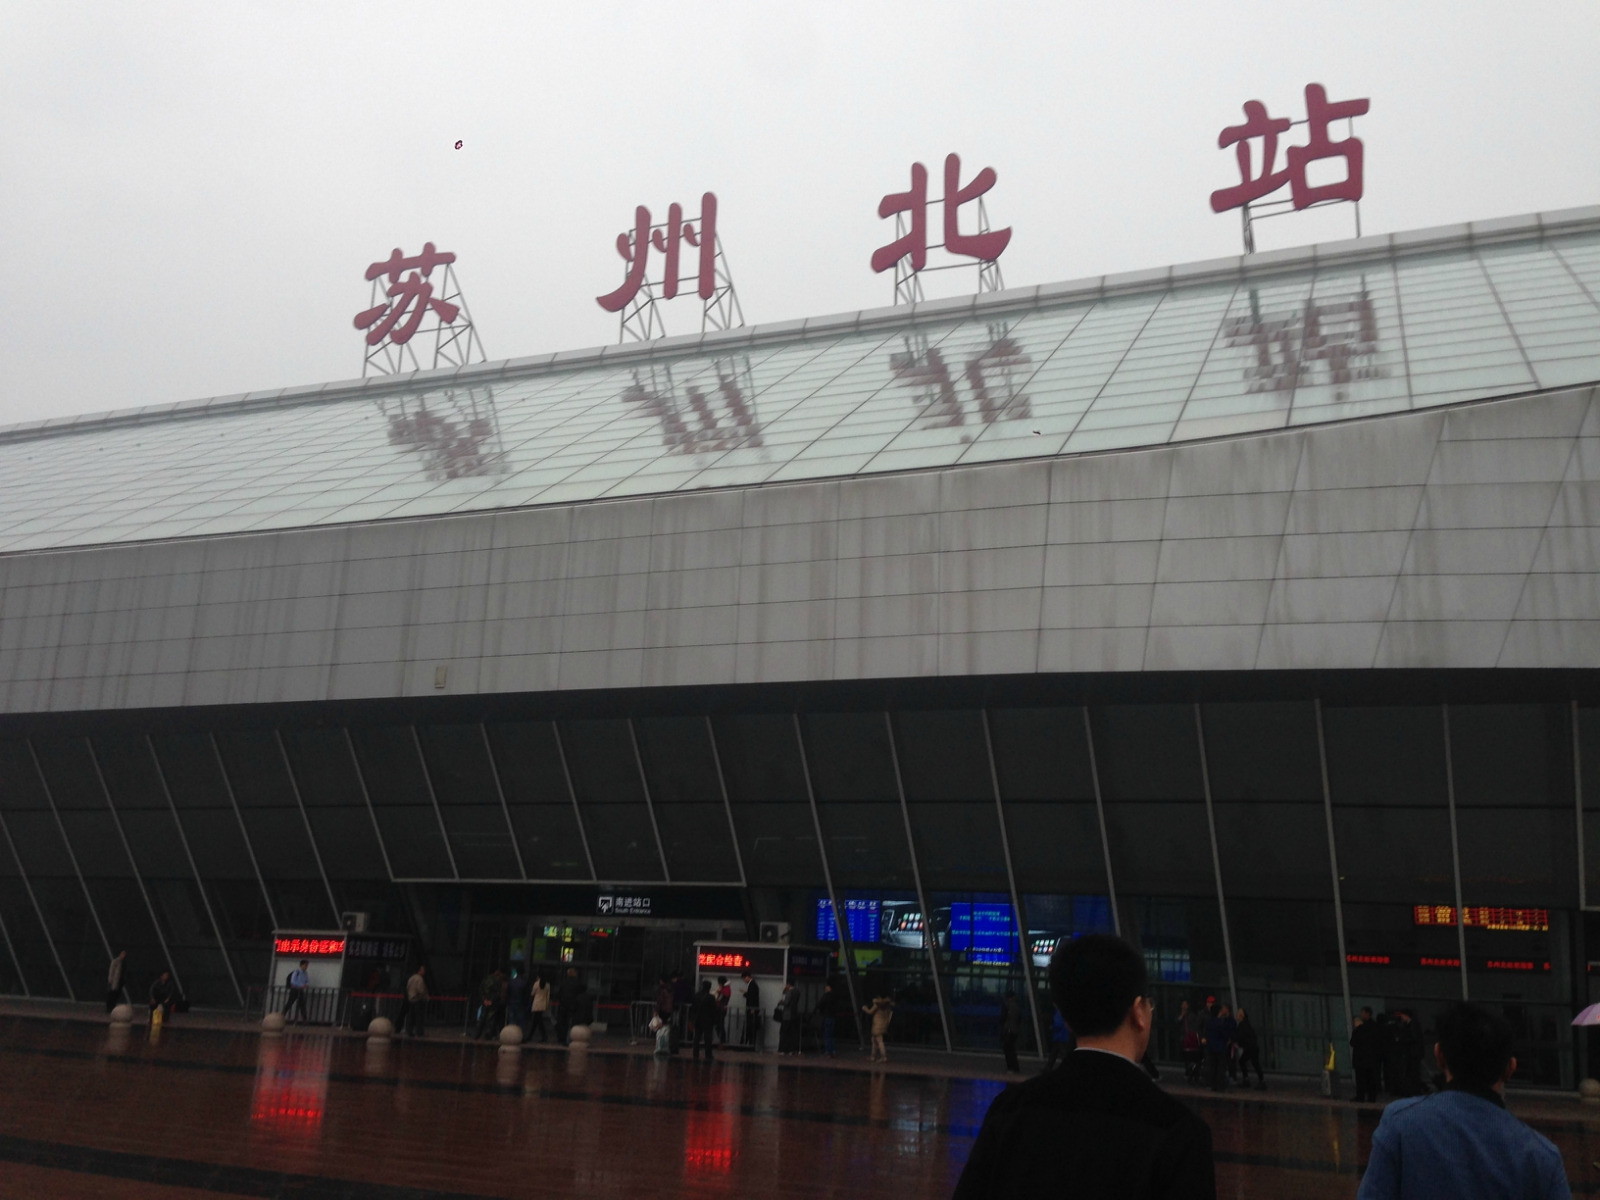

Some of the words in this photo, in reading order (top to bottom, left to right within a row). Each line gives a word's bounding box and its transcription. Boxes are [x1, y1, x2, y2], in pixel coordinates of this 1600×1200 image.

[354, 82, 1370, 346] 苏州北站
[615, 896, 652, 908] 南进站口
